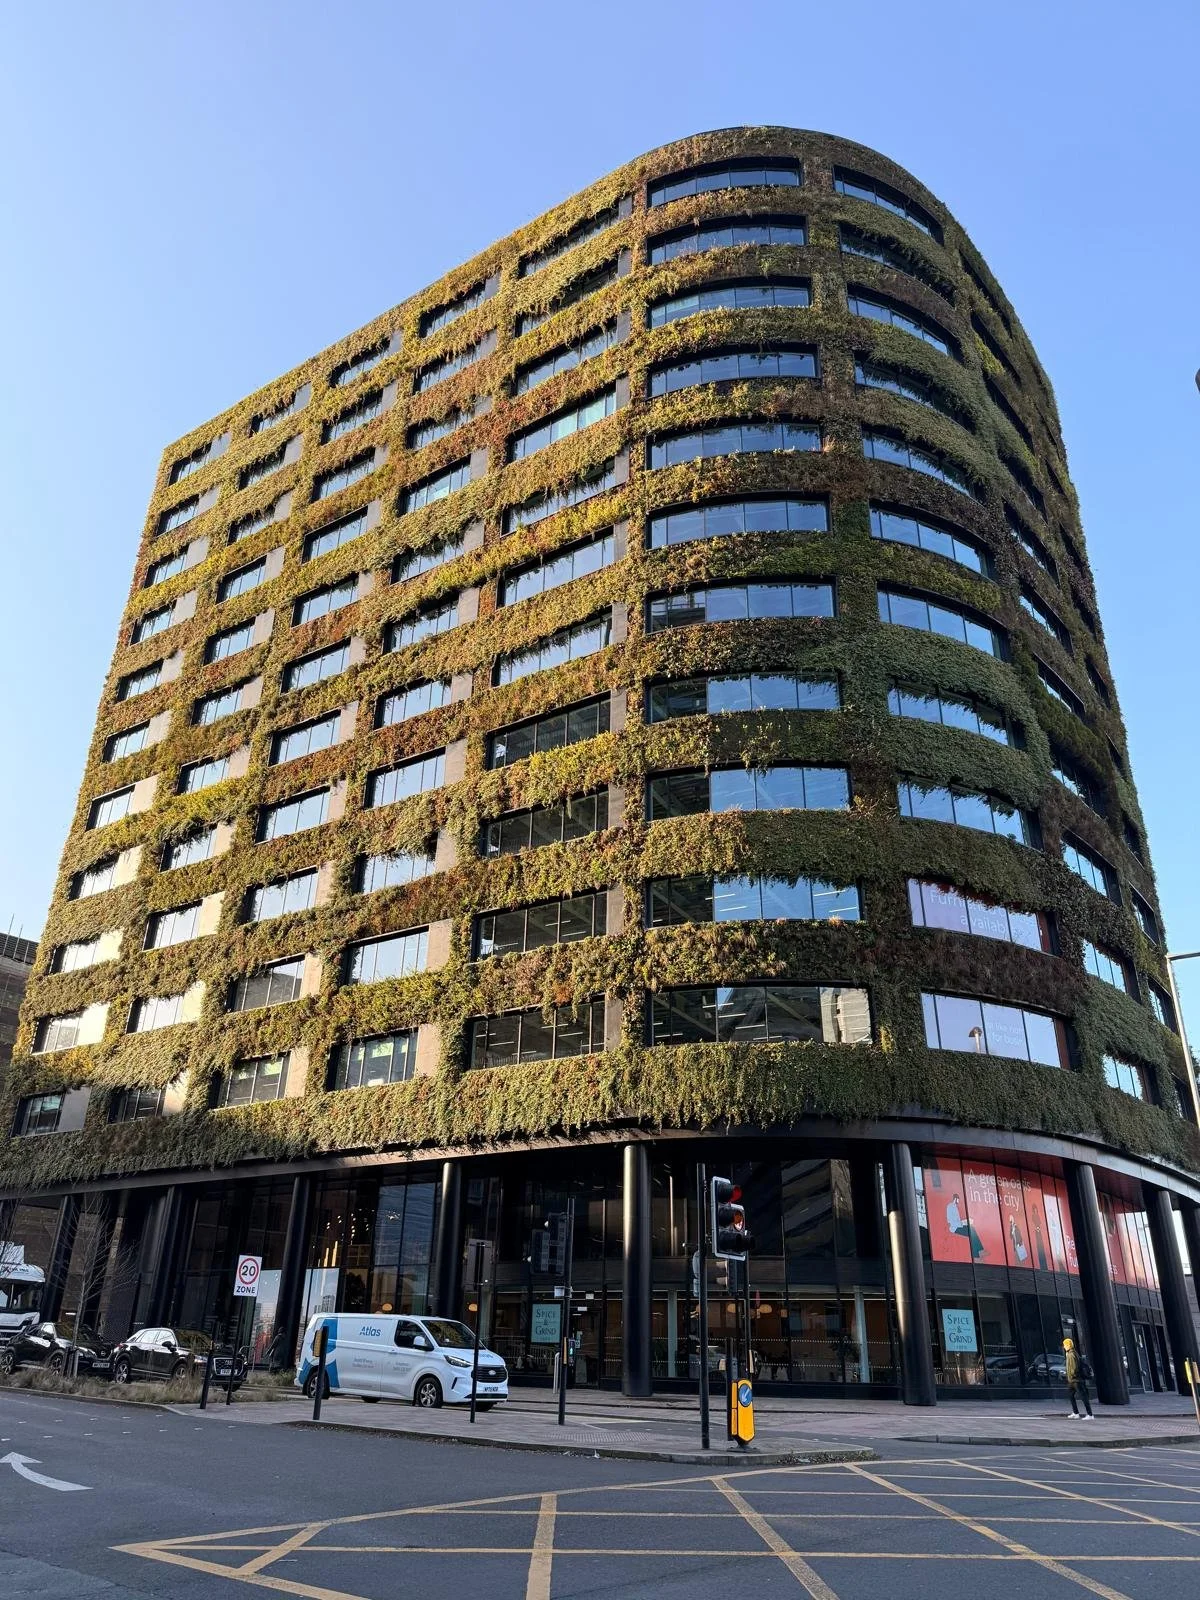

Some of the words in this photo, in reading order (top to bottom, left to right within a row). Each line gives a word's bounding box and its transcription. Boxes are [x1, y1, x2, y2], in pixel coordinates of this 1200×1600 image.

[968, 1168, 978, 1184] A
[979, 1173, 1011, 1188] green
[969, 1186, 982, 1202] in
[984, 1188, 1003, 1205] the
[1003, 1191, 1020, 1212] city
[241, 1265, 256, 1277] 20
[236, 1286, 256, 1294] ZONE
[360, 1326, 381, 1337] Atlas
